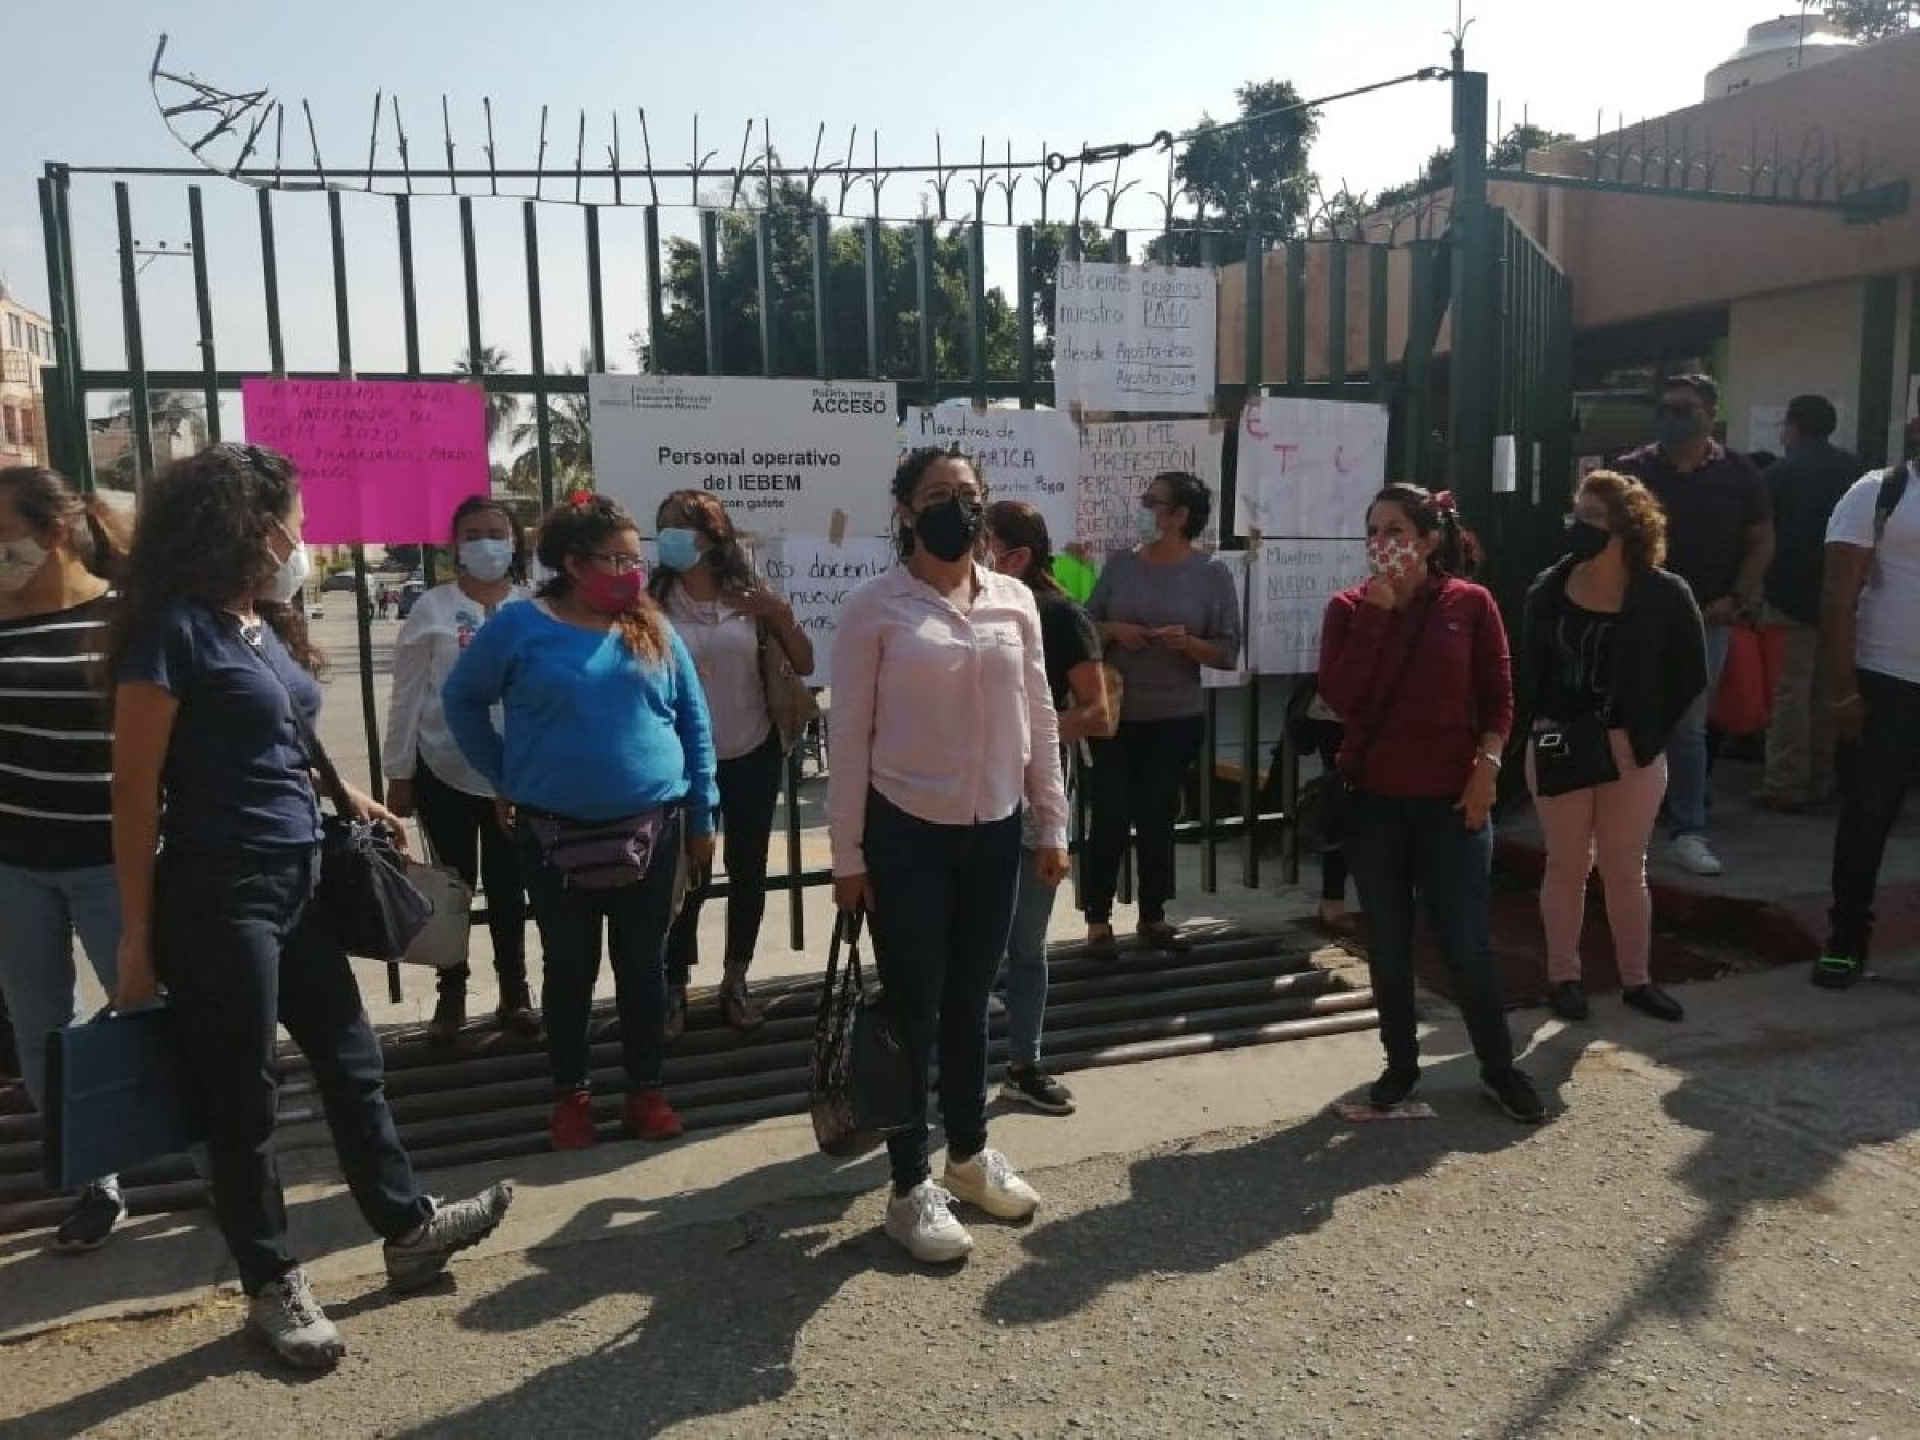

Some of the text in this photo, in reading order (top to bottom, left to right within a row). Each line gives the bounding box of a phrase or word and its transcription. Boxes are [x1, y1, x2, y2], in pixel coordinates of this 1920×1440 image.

[1060, 296, 1190, 328] nuestro PAGO
[1063, 335, 1104, 361] desde
[812, 398, 887, 415] ACCESO
[920, 411, 1017, 440] Maestros de
[1097, 425, 1137, 448] AMO
[658, 446, 841, 469] Personal operativo
[703, 474, 801, 491] del IEBEM
